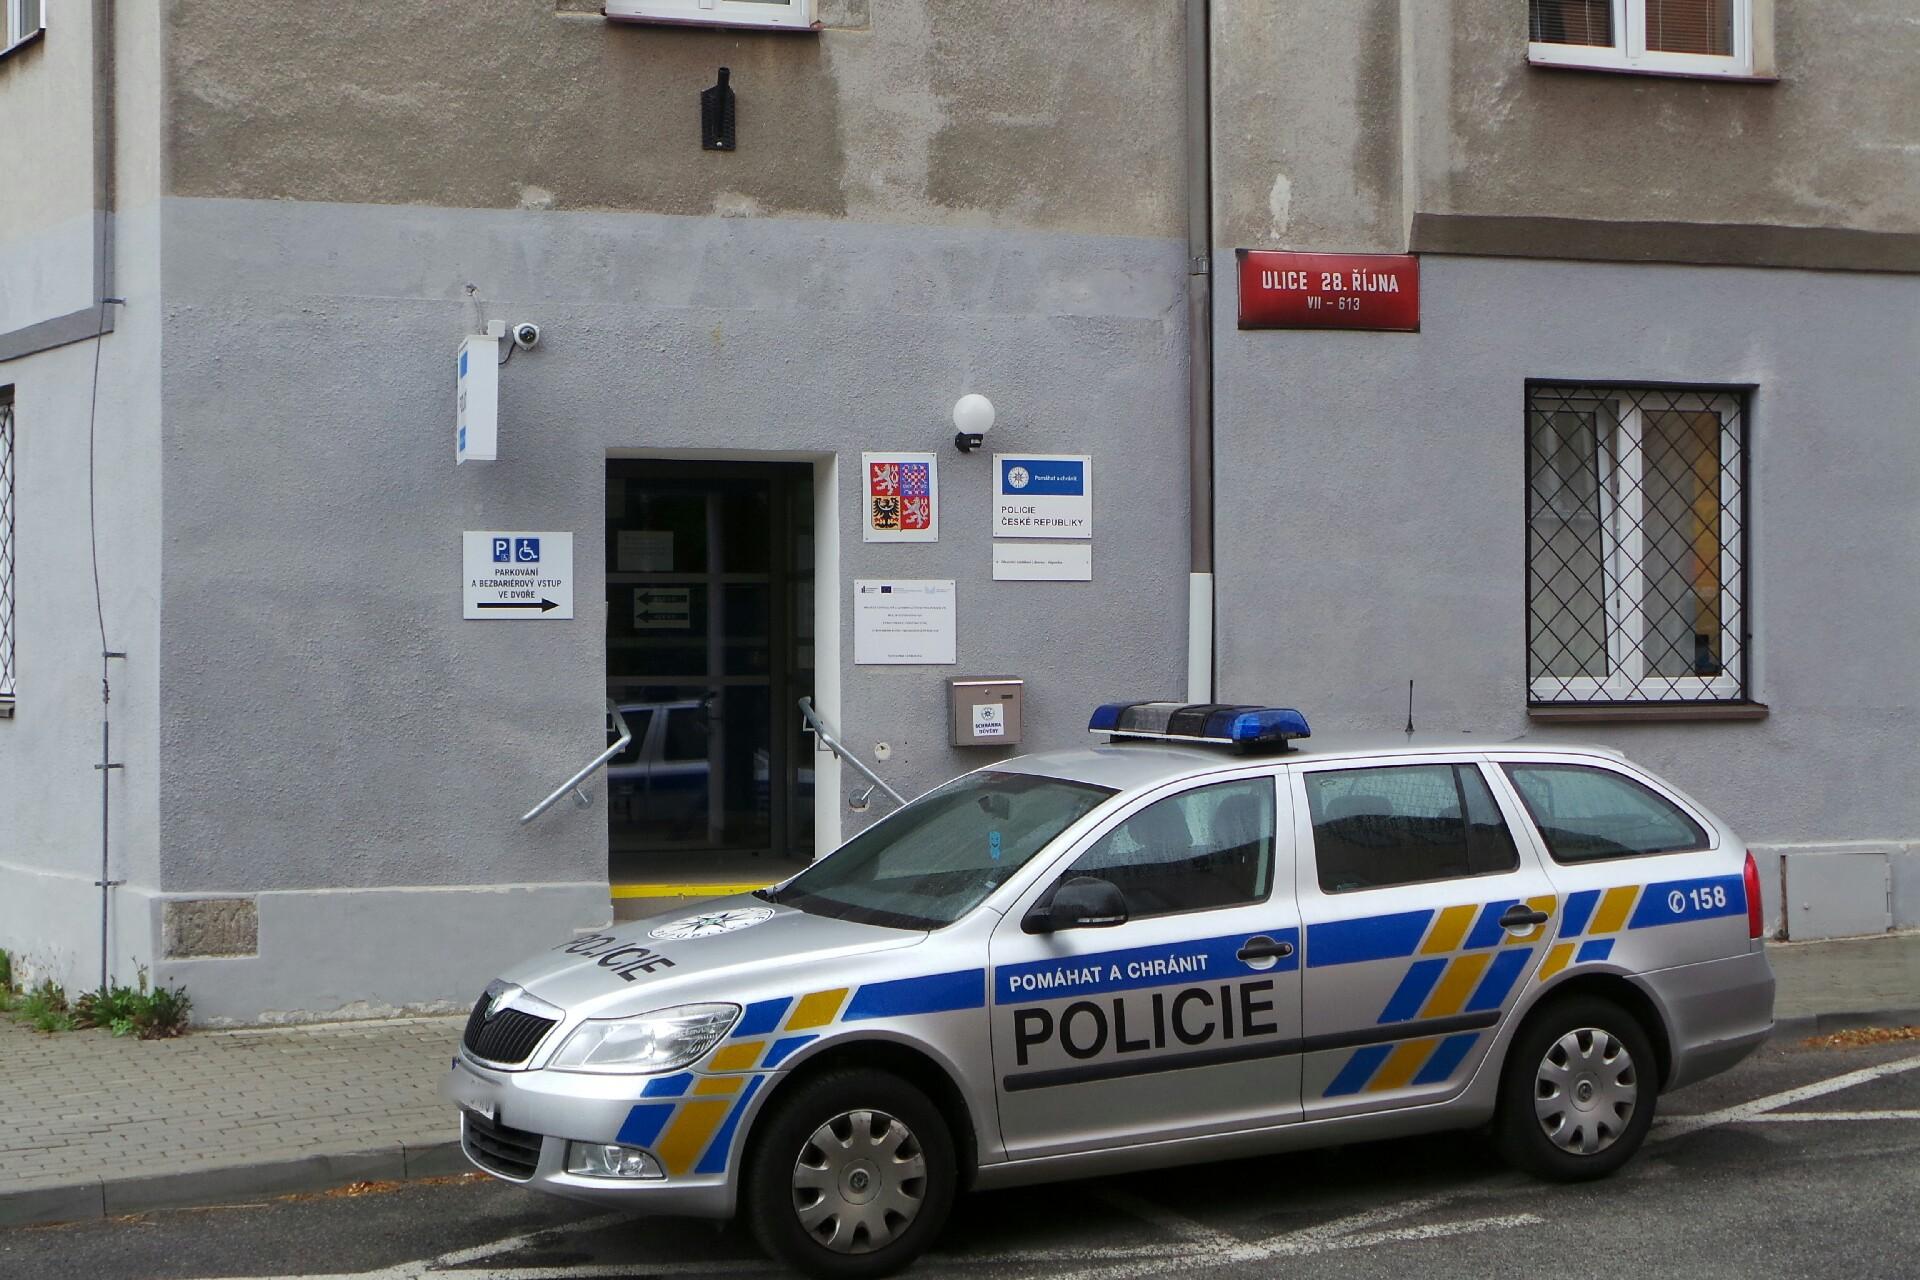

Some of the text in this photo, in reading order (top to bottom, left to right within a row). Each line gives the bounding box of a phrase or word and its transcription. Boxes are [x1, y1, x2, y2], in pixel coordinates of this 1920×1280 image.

[1262, 269, 1399, 293] ULICE 28. ŘÍJNA
[1307, 296, 1321, 309] VII
[1338, 297, 1360, 310] 613
[1001, 506, 1036, 514] POLICIE
[1001, 516, 1083, 527] ČESKÉ REPUBLIKY
[495, 567, 539, 577] PARKOVÁNÍ
[471, 578, 562, 588] A BEZBARIÉROVÝ VSTUP
[498, 589, 536, 599] VE DVOŘE
[1689, 885, 1726, 911] 158
[551, 934, 677, 983] POLICIE
[1009, 954, 1208, 993] POMÁHAT A CHRÁNIT
[1013, 979, 1278, 1066] POLICIE
